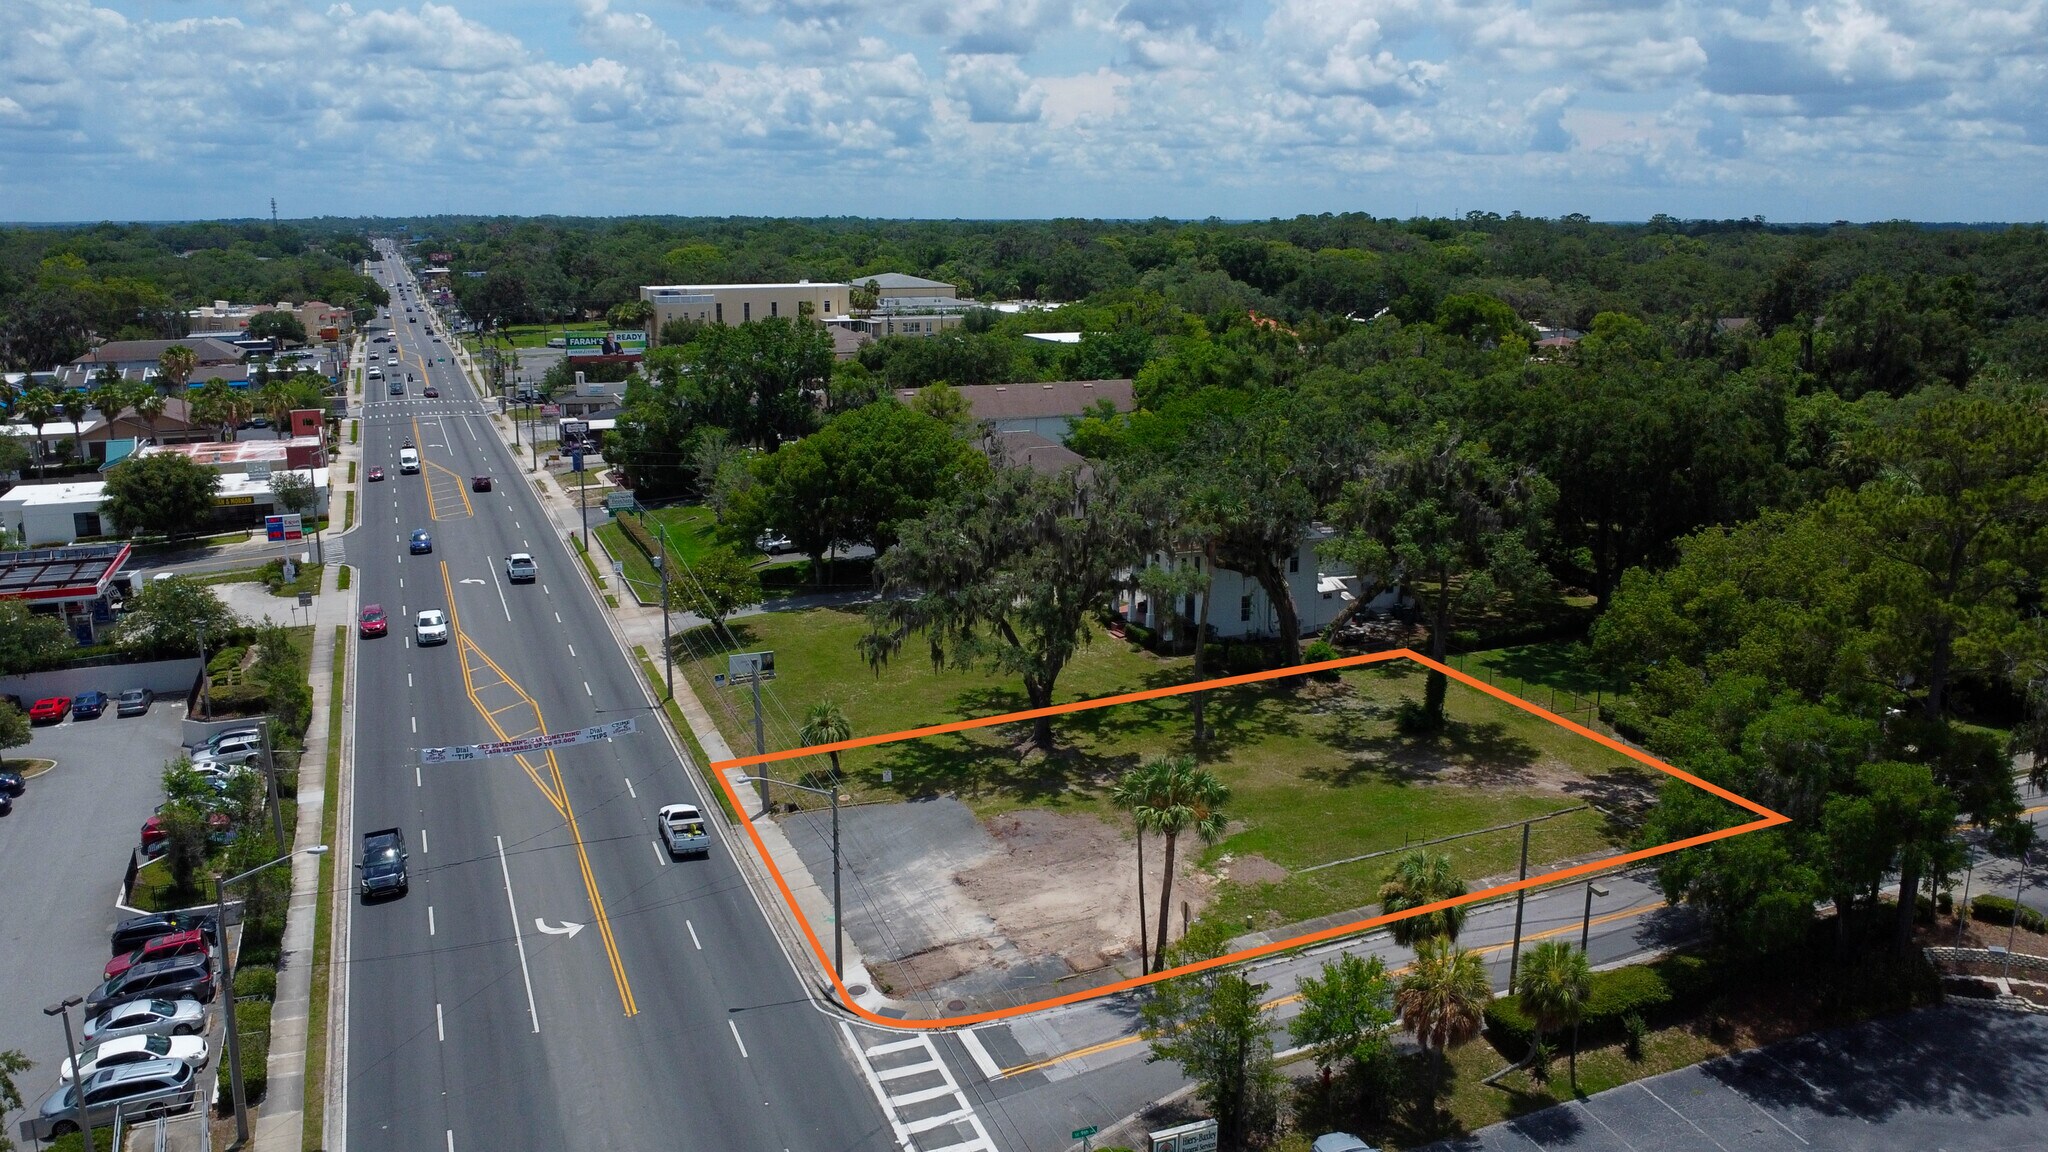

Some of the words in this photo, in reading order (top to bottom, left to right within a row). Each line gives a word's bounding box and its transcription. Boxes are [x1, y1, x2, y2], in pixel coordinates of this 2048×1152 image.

[617, 333, 642, 341] READY
[589, 727, 603, 735] Dial
[503, 745, 531, 753] REWARDS
[1182, 1130, 1217, 1146] Hiers-Baxley
[1199, 1142, 1217, 1151] Services
